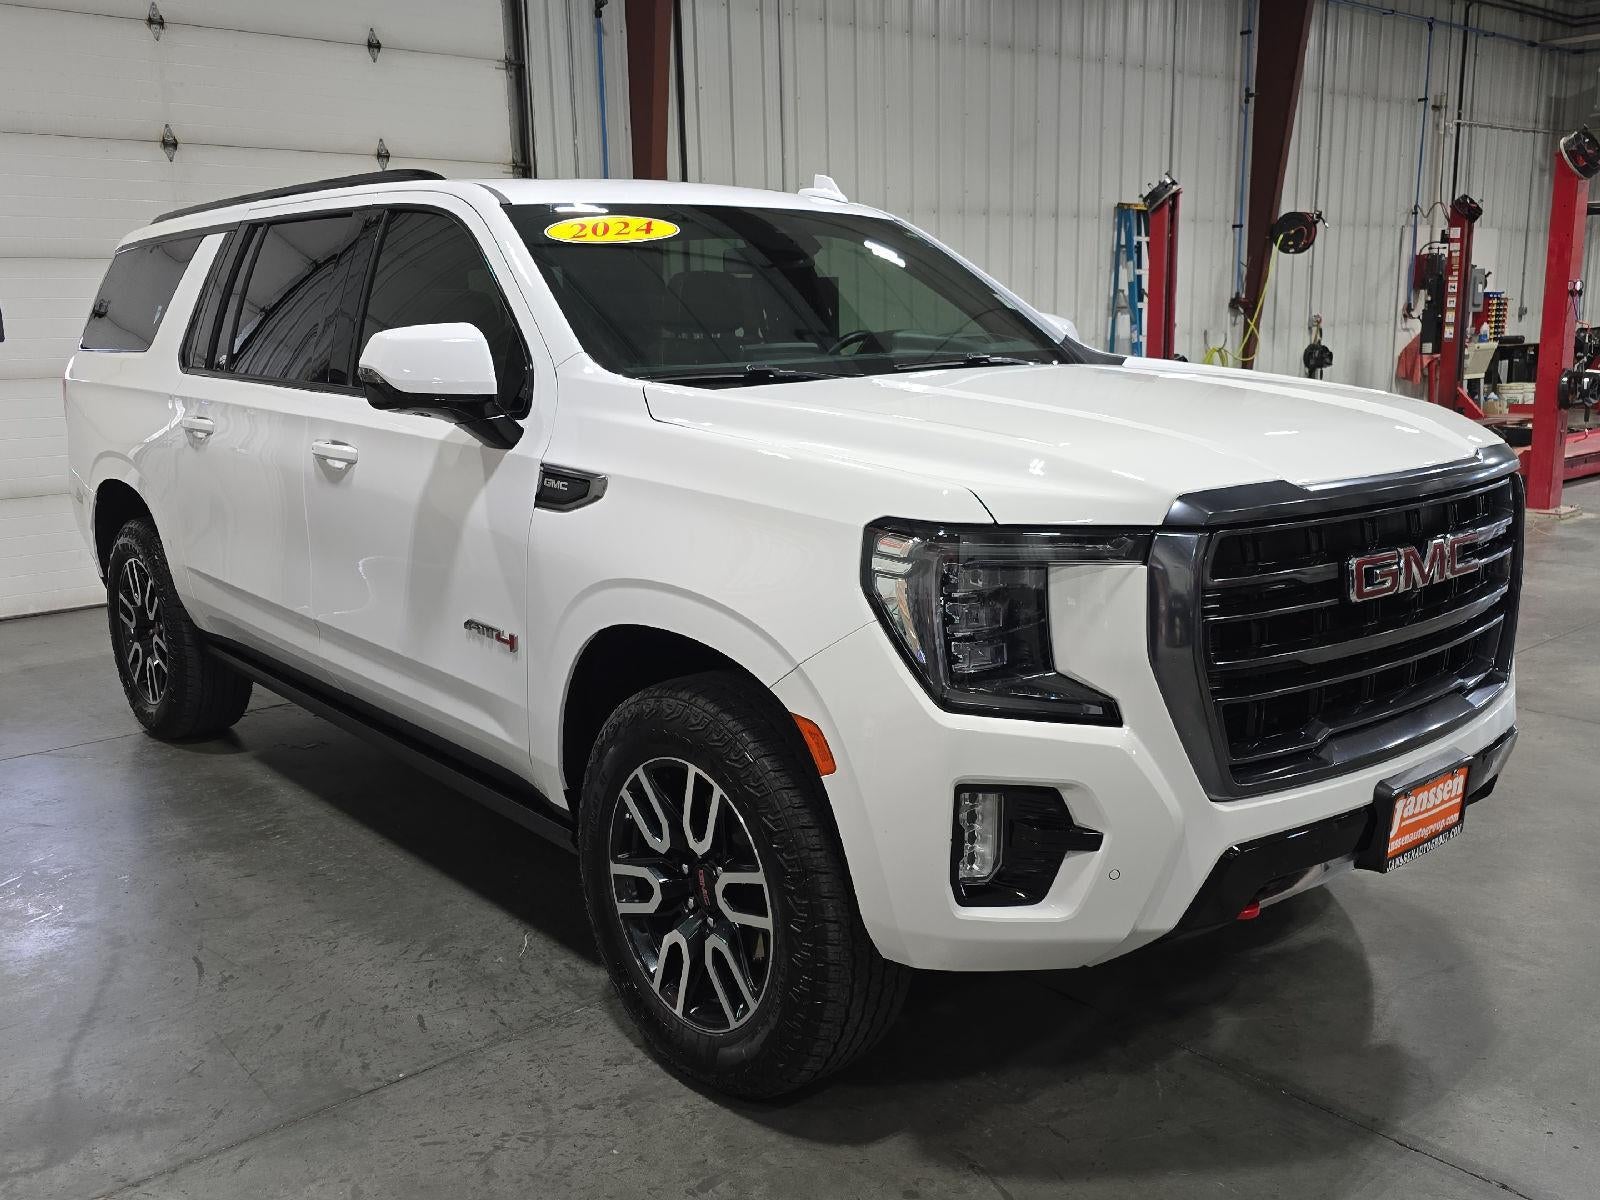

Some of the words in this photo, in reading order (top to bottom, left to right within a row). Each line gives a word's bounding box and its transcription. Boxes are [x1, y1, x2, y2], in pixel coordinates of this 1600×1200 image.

[569, 219, 654, 239] 2024
[543, 478, 568, 491] GMC
[1349, 532, 1479, 603] GMC
[463, 618, 519, 653] AT4
[1389, 774, 1465, 839] Janssen
